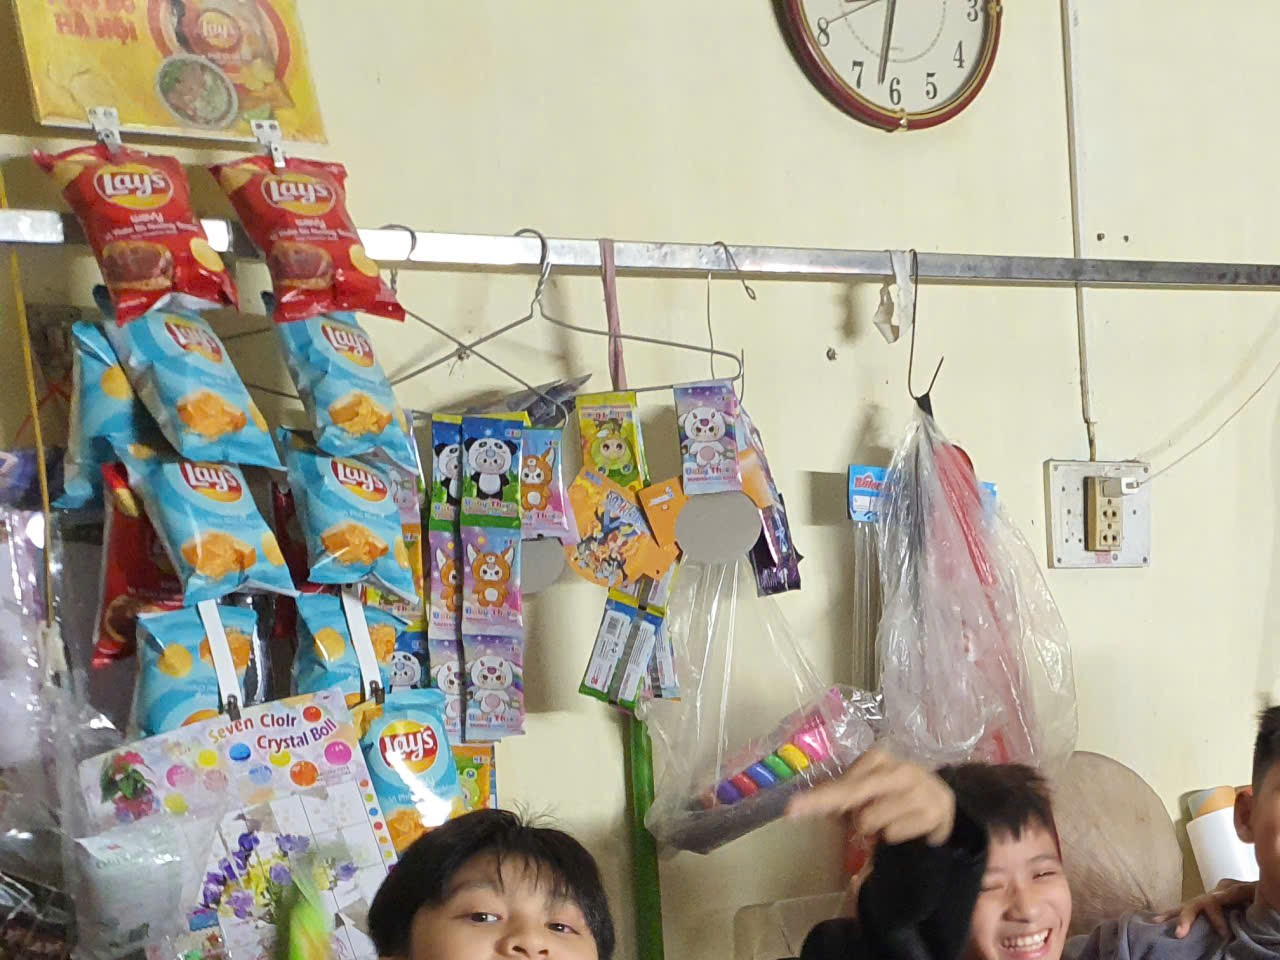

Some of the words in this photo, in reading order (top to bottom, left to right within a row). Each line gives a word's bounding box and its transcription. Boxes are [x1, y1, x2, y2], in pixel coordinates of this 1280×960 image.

[817, 17, 830, 47] 8
[953, 40, 965, 68] 4
[852, 60, 864, 89] 7
[926, 72, 938, 100] 5
[889, 77, 902, 105] 6
[208, 718, 254, 744] Seven
[257, 731, 309, 756] Crystal
